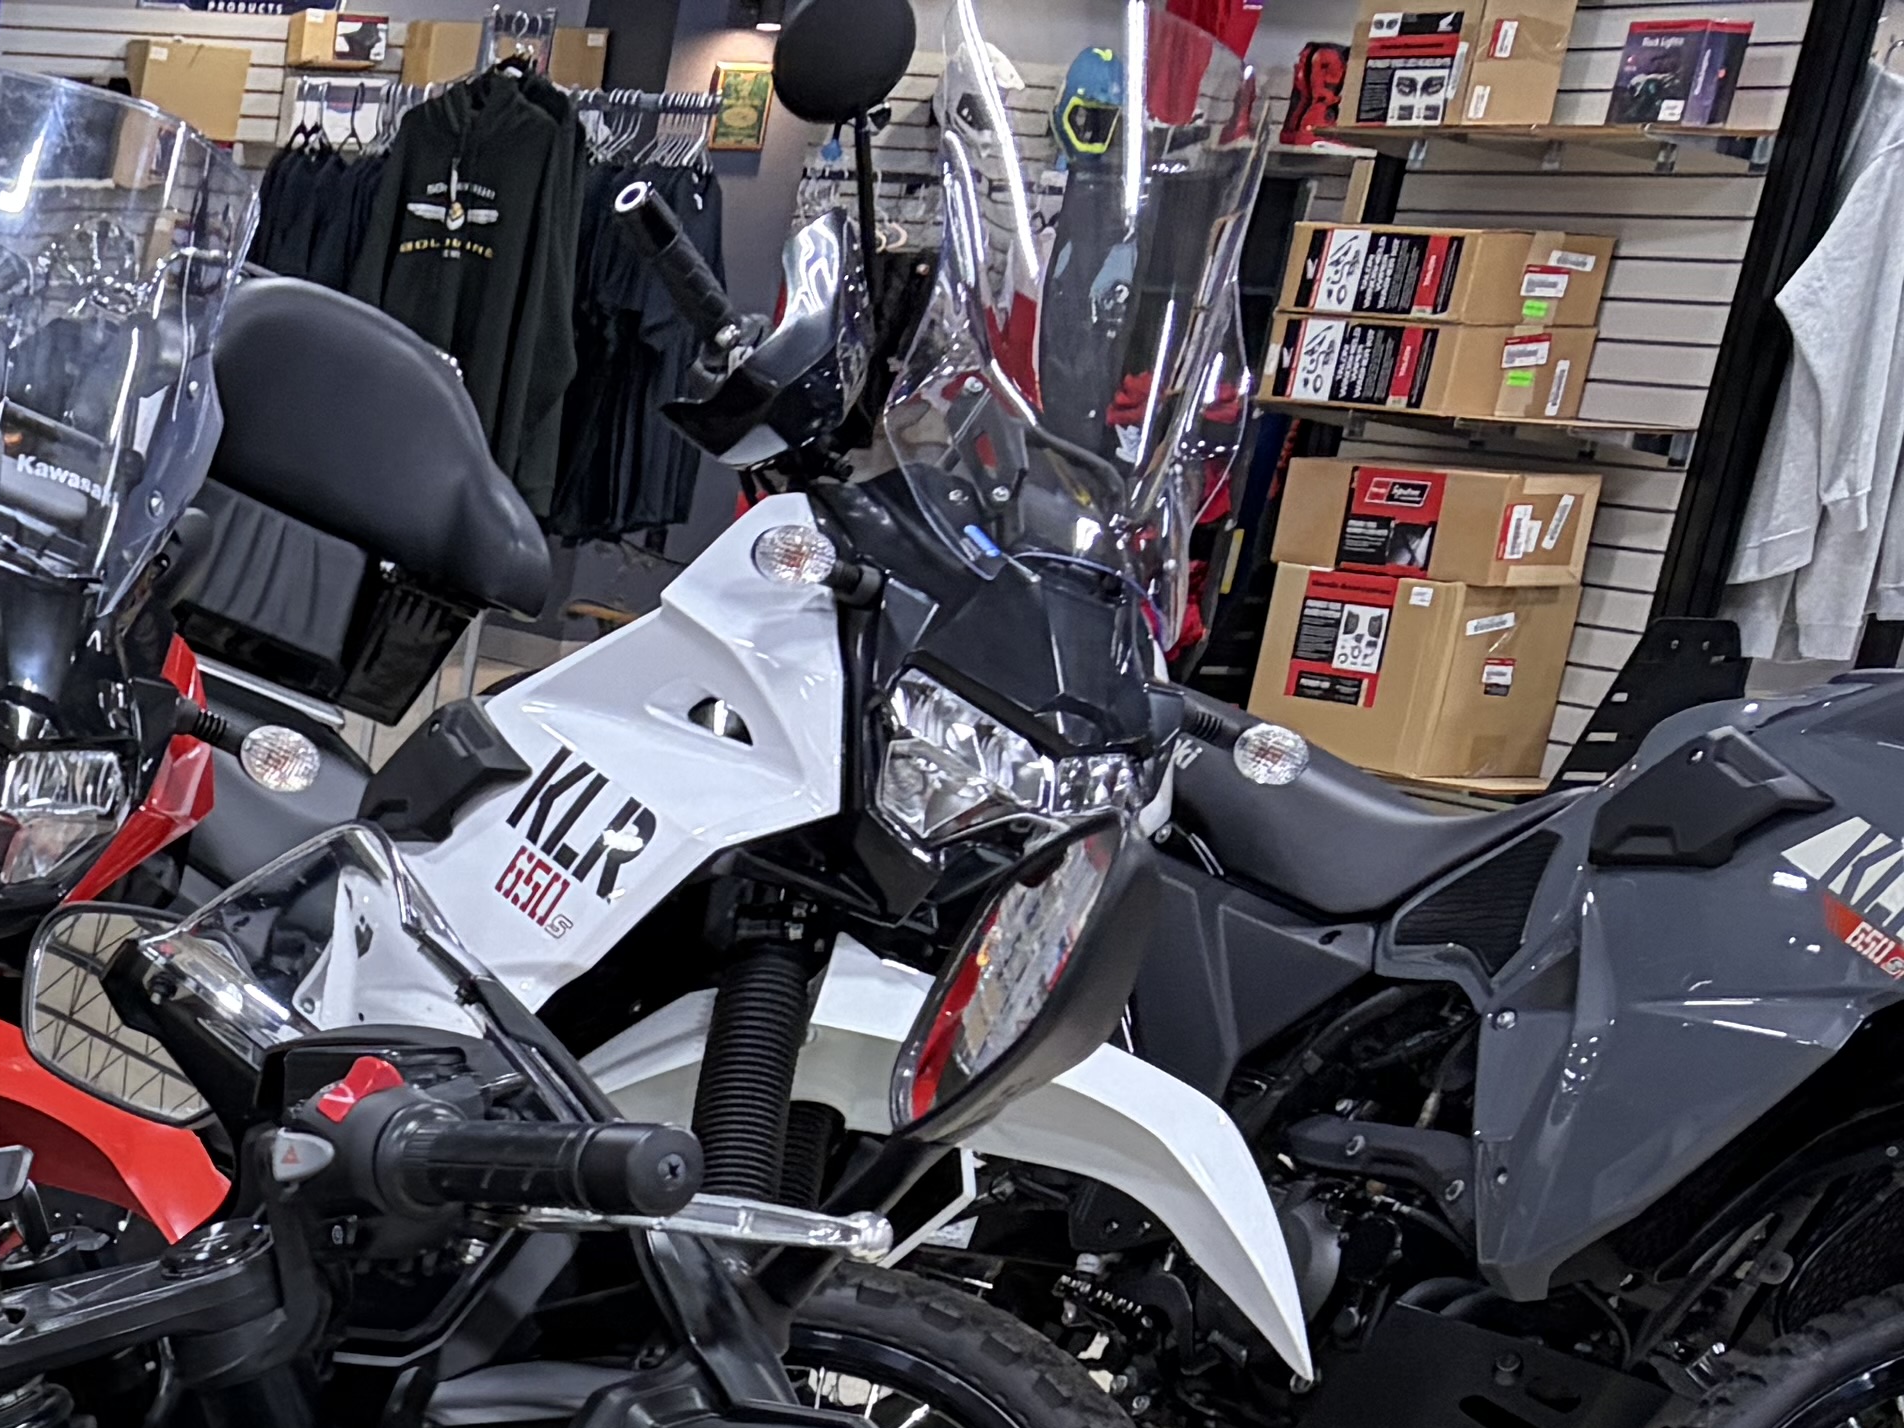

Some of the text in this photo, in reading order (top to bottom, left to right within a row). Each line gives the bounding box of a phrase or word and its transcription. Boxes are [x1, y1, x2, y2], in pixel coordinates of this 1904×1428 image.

[206, 0, 284, 15] PRODUCTS
[505, 744, 658, 905] KLR
[494, 844, 571, 927] 650
[1844, 920, 1896, 965] 650
